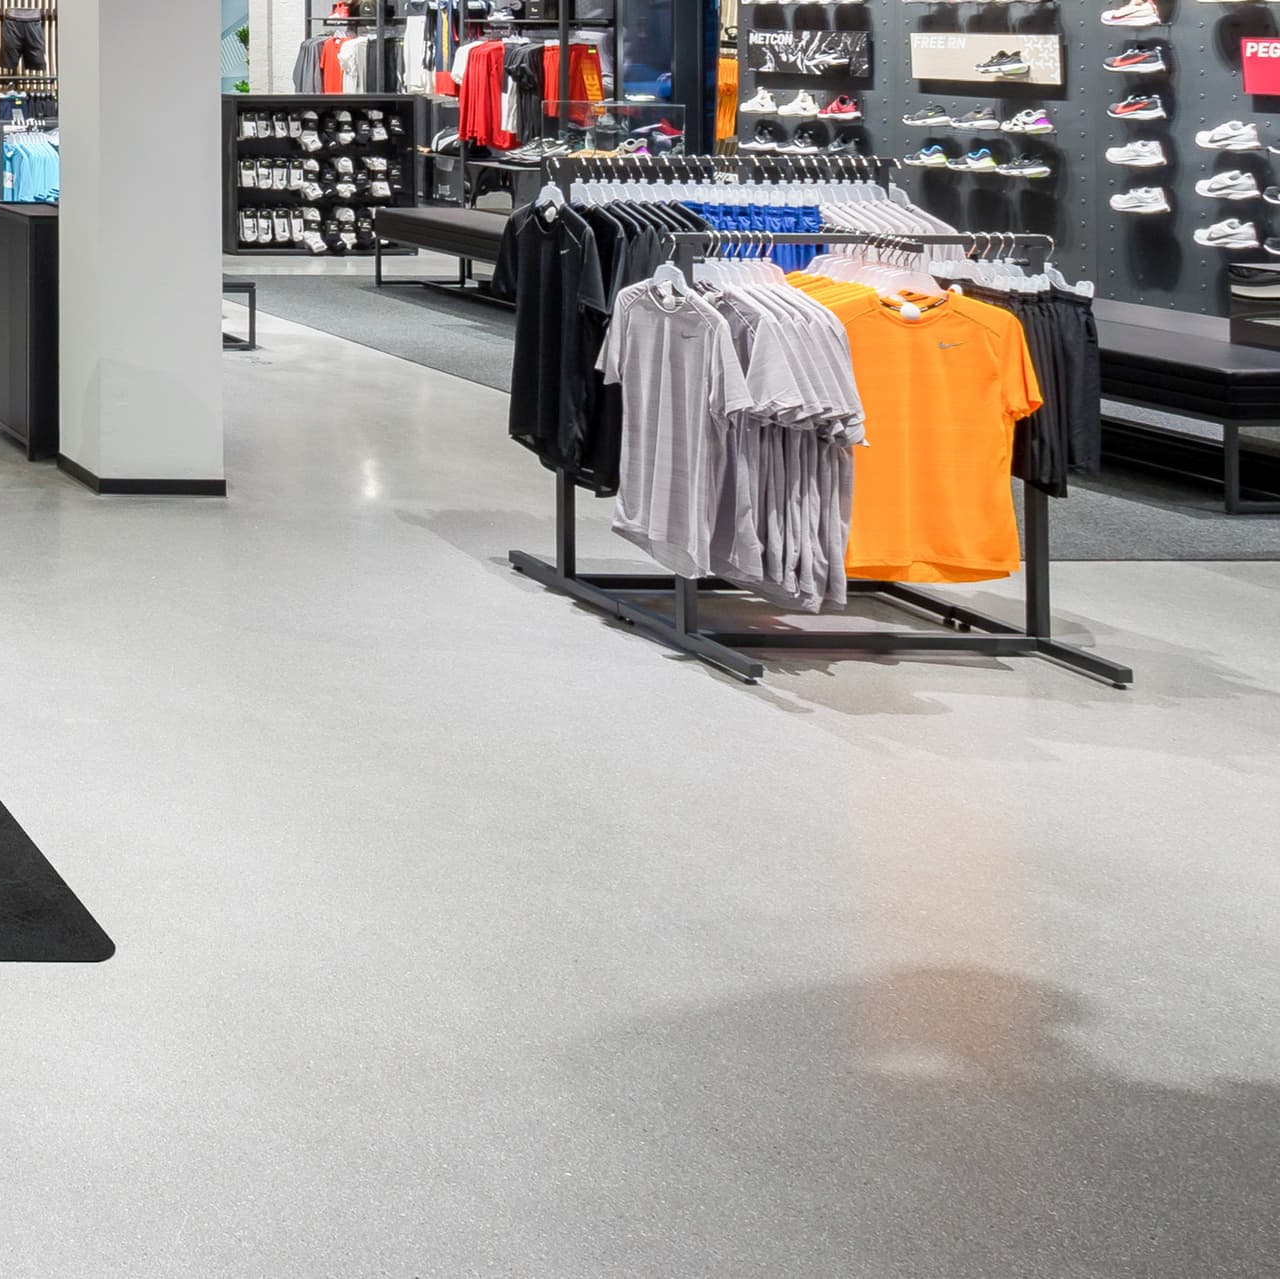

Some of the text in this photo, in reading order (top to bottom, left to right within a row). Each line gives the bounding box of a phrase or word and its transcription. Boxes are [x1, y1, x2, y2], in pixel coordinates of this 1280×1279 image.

[749, 33, 793, 45] METCON
[913, 36, 966, 48] FREE RN
